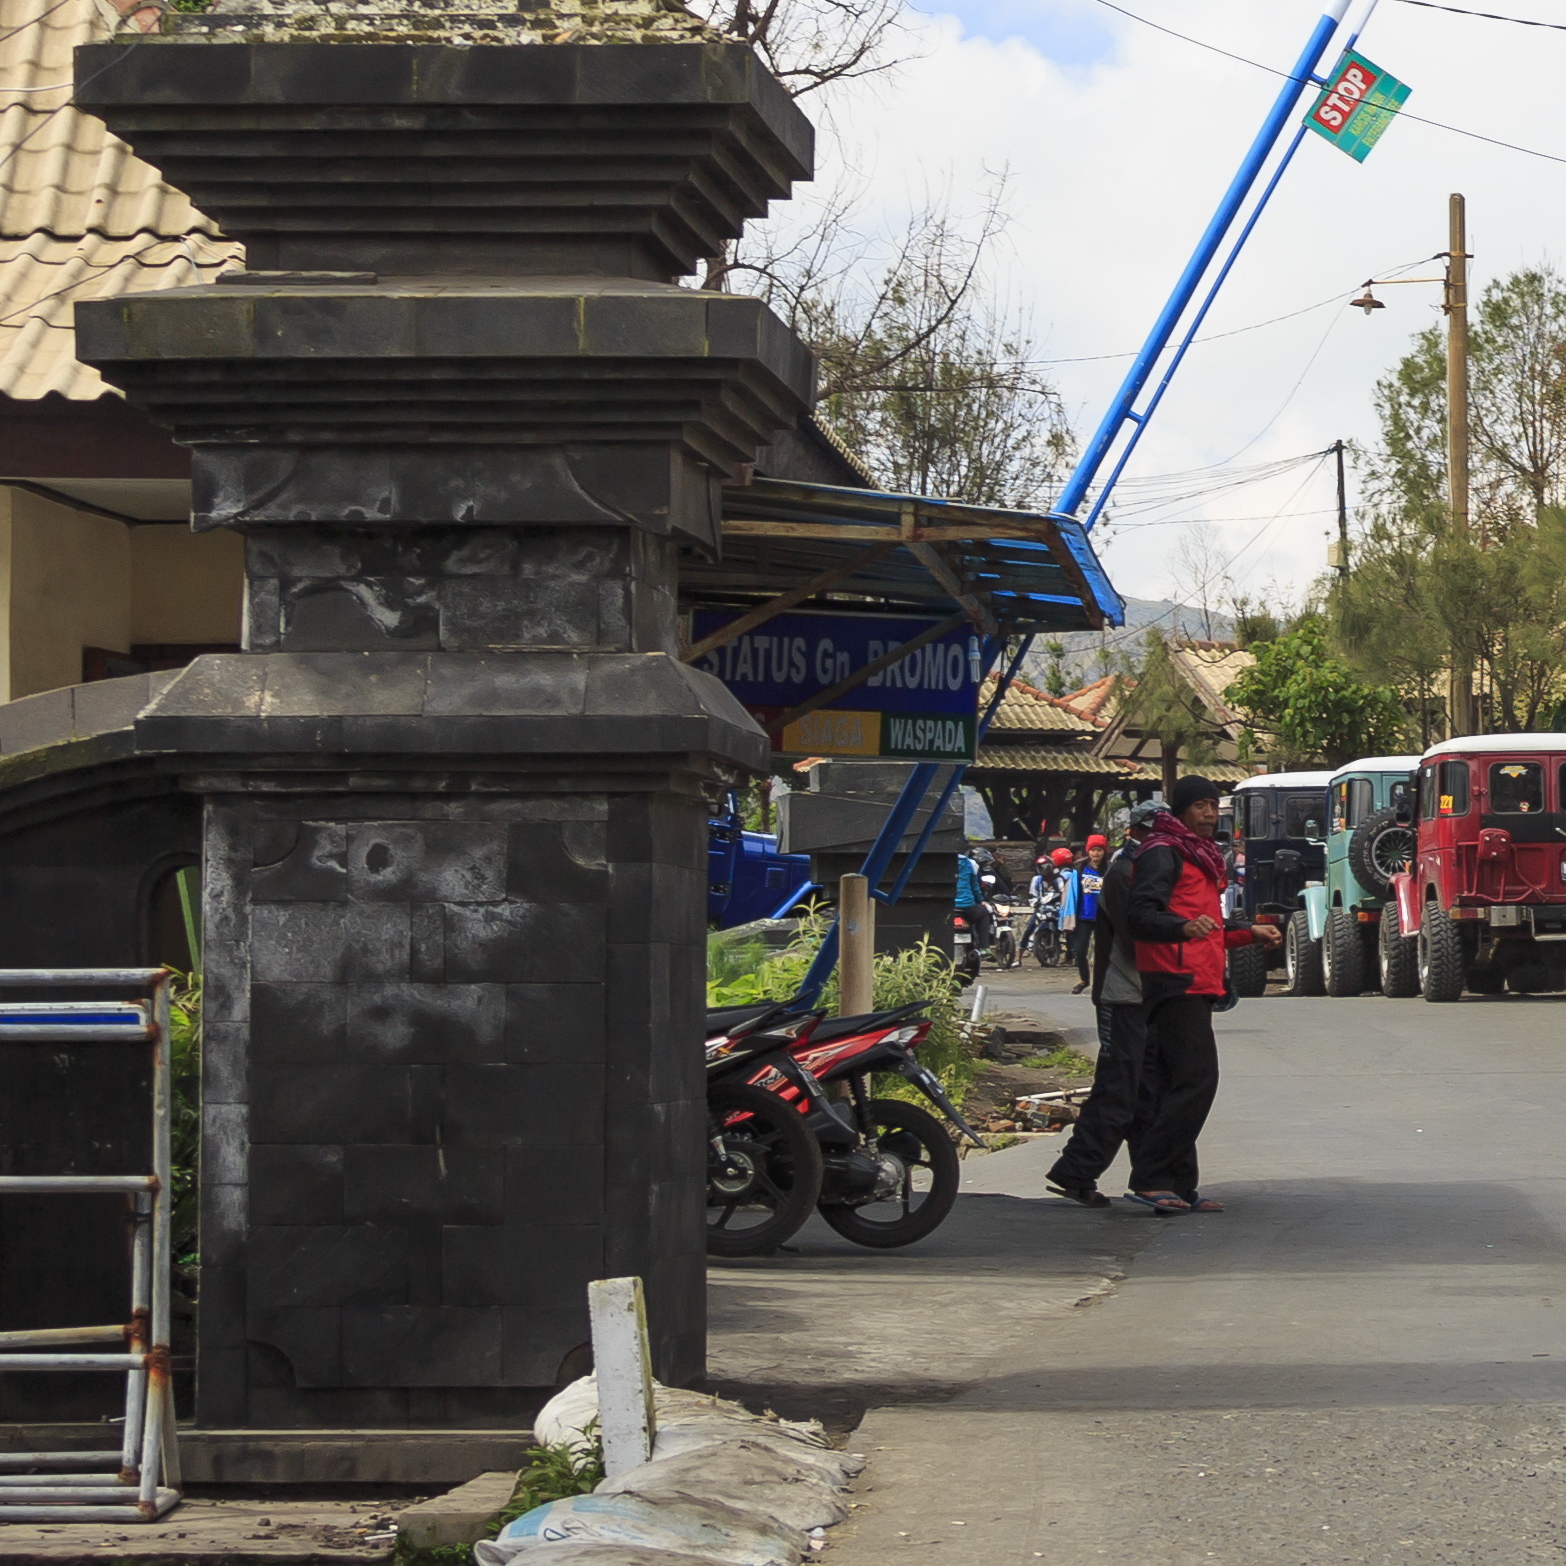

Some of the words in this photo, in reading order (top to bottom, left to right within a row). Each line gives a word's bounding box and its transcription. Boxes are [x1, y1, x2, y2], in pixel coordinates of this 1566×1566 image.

[1319, 67, 1367, 127] STOP
[703, 635, 807, 684] STATUS
[866, 639, 965, 691] BROMO
[799, 714, 864, 749] SIAGA
[890, 717, 966, 753] WASPADA
